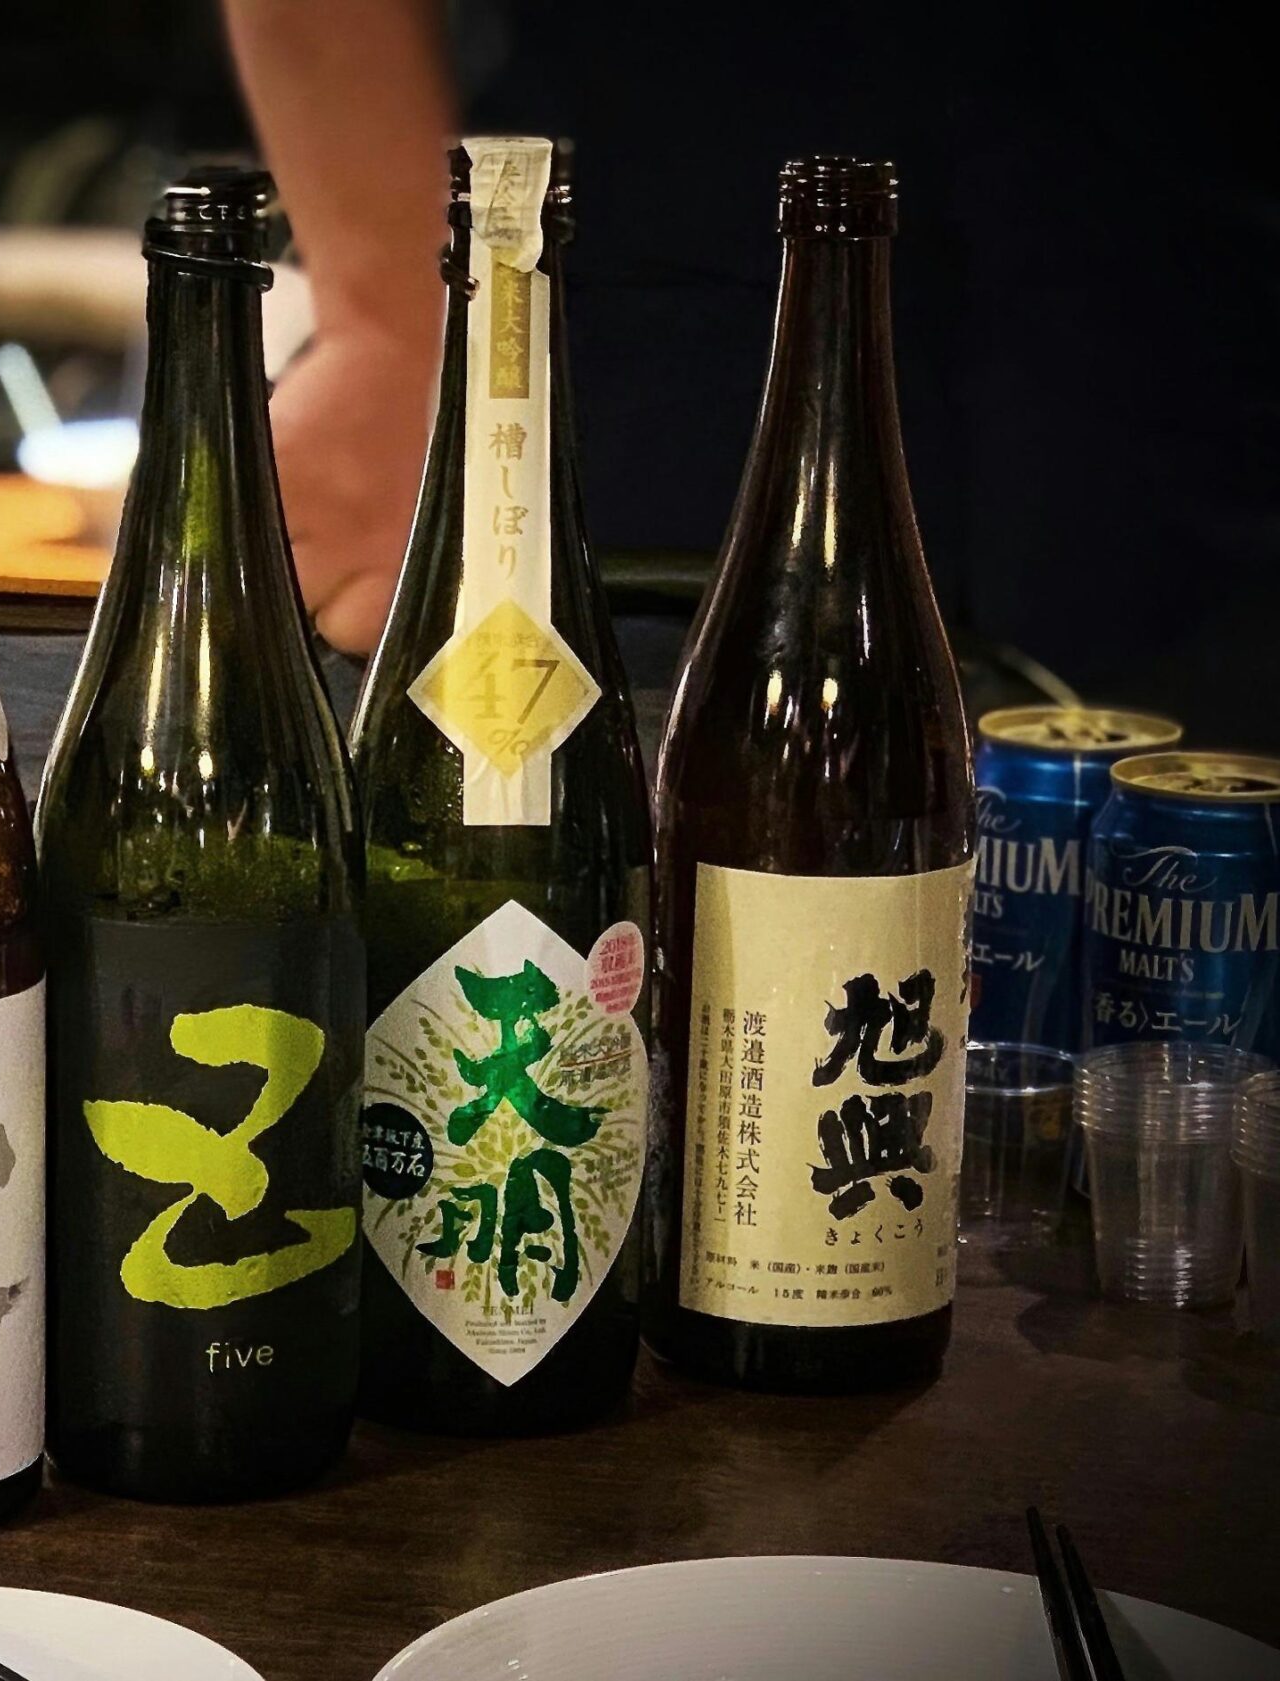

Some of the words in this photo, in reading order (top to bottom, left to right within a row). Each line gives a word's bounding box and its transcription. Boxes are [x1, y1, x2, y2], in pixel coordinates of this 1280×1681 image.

[488, 422, 529, 580] 槽しぼり
[1116, 846, 1218, 892] The
[1085, 866, 1280, 954] PREMIUM
[1120, 949, 1195, 984] MALT'S
[806, 968, 948, 1221] 旭興
[824, 1221, 925, 1247] きょくこう
[205, 1342, 275, 1373] five
